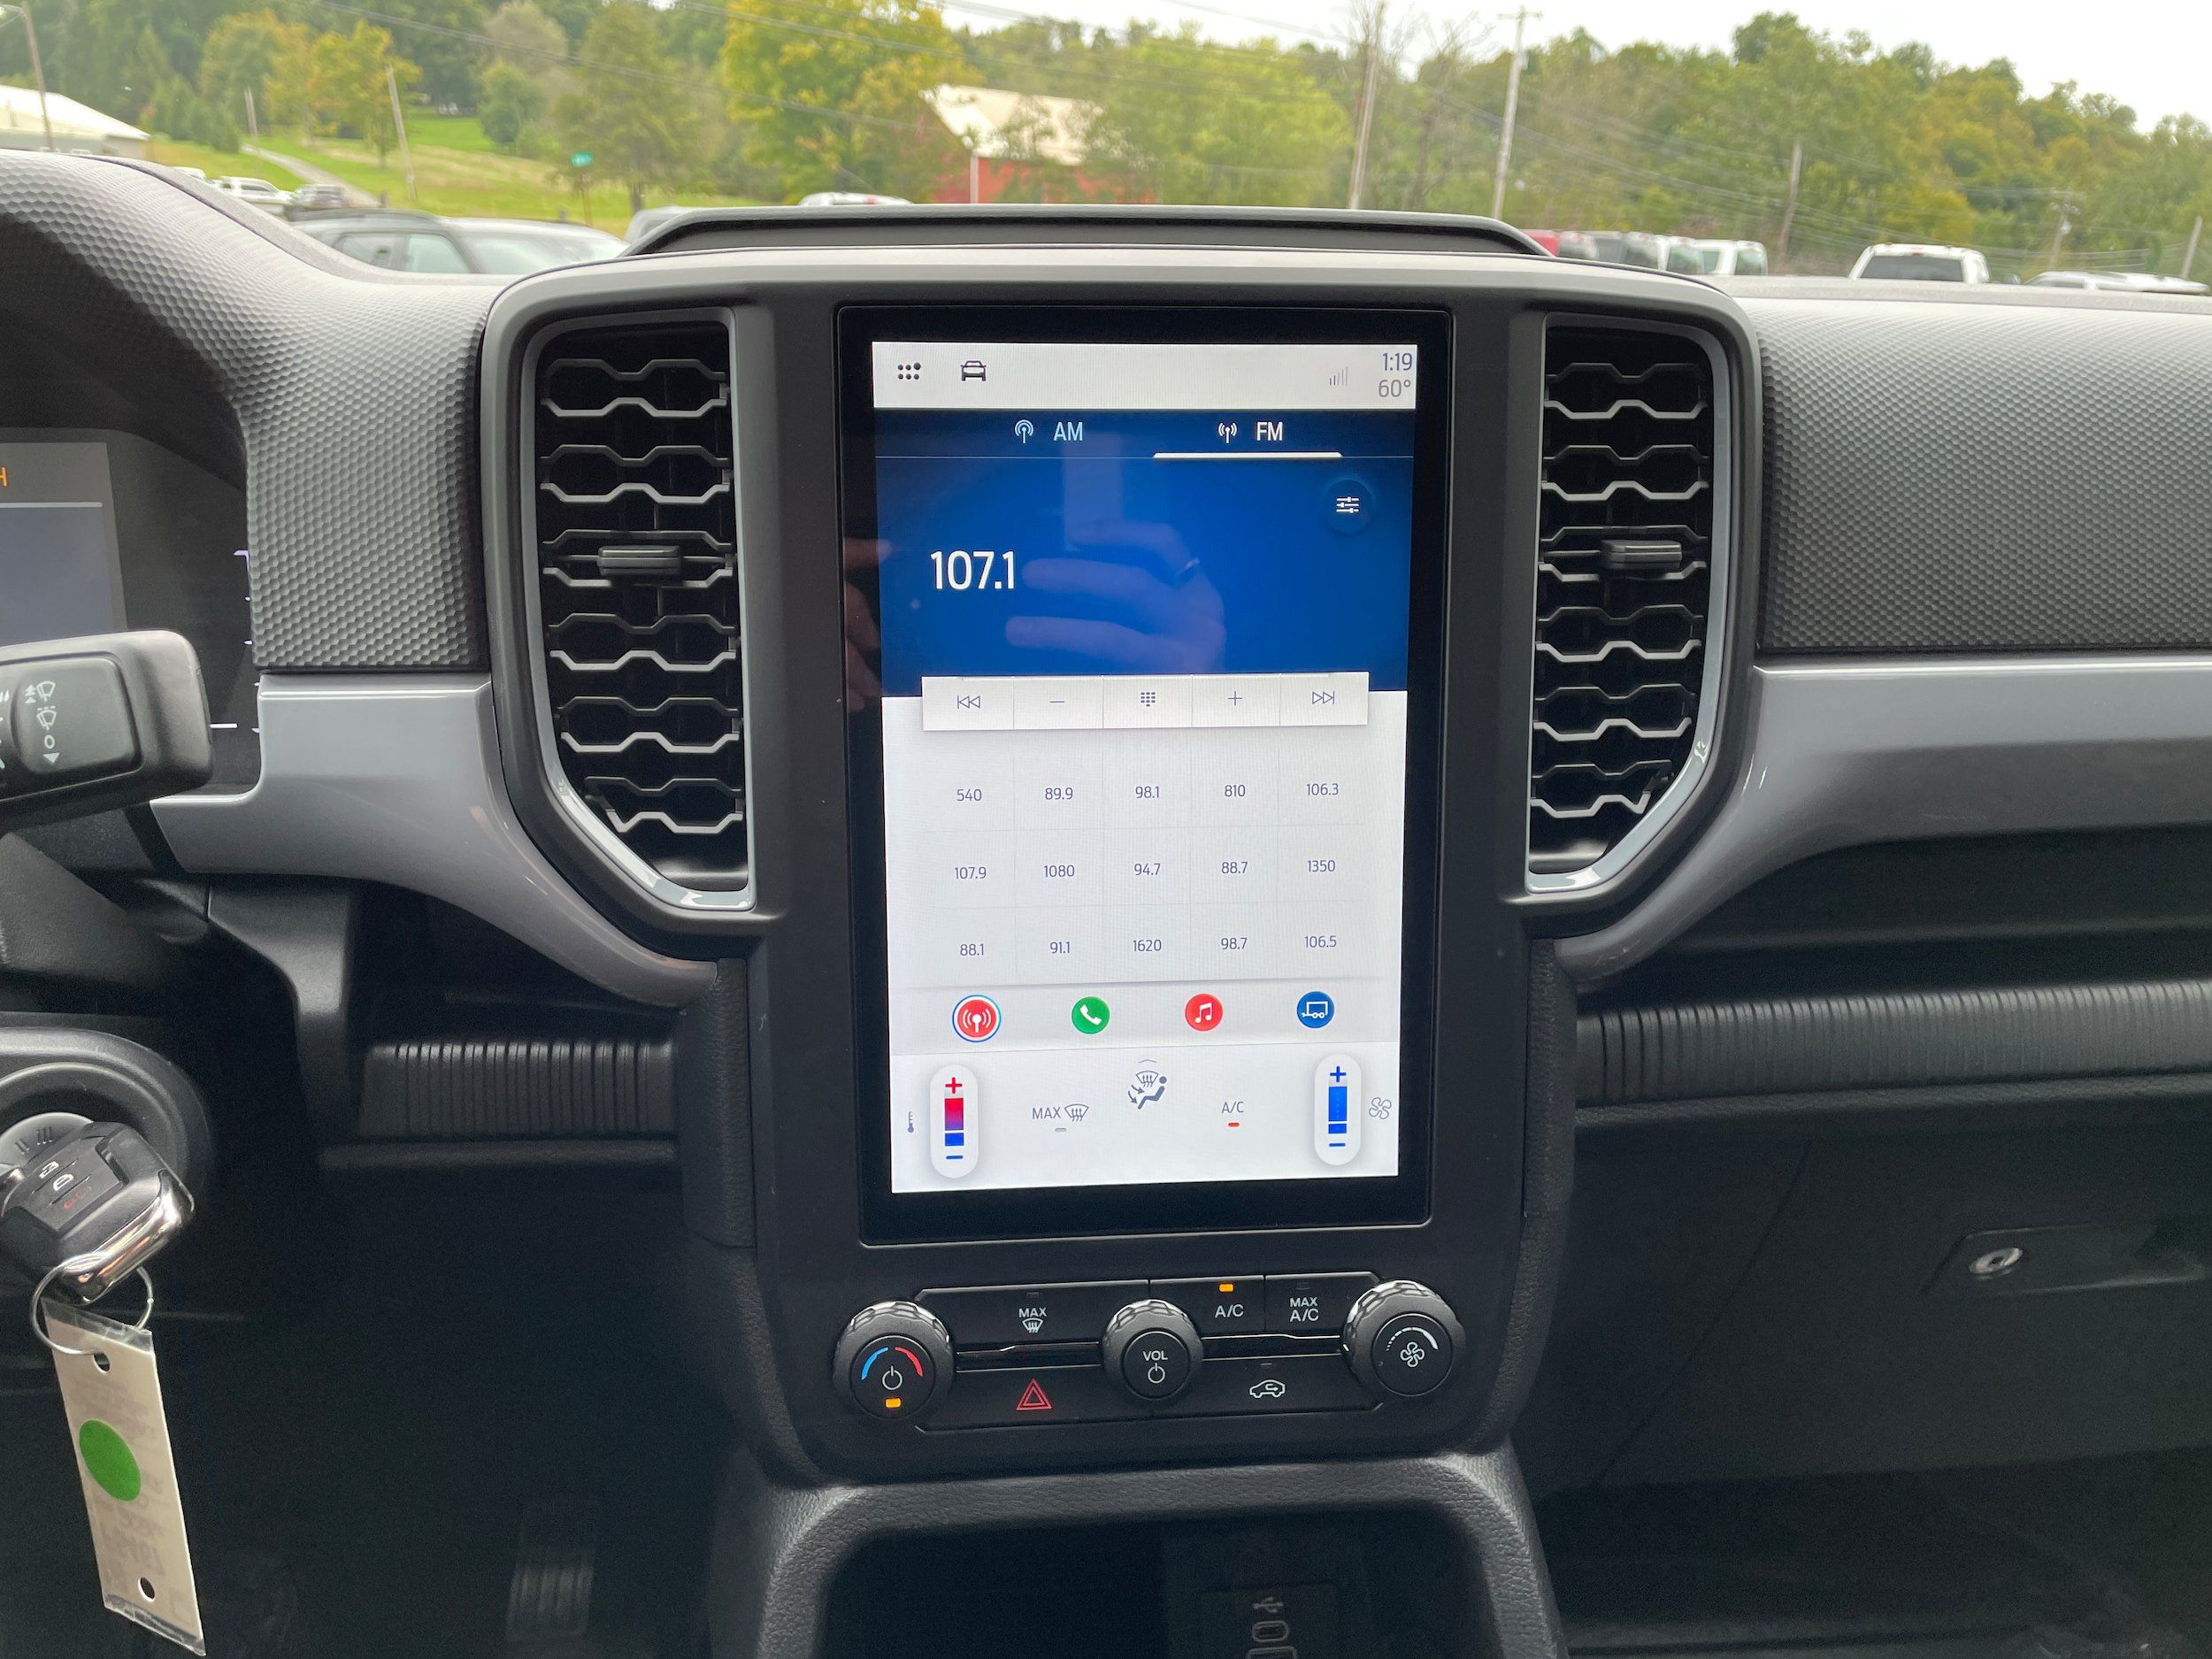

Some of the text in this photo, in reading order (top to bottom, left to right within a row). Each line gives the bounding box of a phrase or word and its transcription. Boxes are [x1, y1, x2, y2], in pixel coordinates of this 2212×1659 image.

[1382, 352, 1413, 372] 1:19
[1378, 379, 1411, 398] 60°
[1053, 421, 1083, 442] AM
[1256, 421, 1283, 442] FM
[930, 550, 1015, 590] 107.1
[956, 788, 982, 802] 540
[1045, 787, 1073, 801] 89.9
[1135, 786, 1159, 799] 98.1
[1224, 784, 1246, 797] 810
[1307, 782, 1339, 796] 106.3
[1044, 864, 1075, 878] 1080
[1133, 863, 1161, 876] 94.7
[1221, 861, 1248, 874] 88.7
[1308, 859, 1336, 872] 1350
[954, 866, 987, 879] 107.9
[1049, 941, 1071, 954] 91.1
[1133, 939, 1162, 952] 1620
[1220, 937, 1248, 950] 98.7
[1305, 935, 1337, 949] 106.5
[960, 943, 984, 956] 88.1
[1032, 1106, 1061, 1119] MAX
[1221, 1101, 1244, 1114] A/C
[1289, 1296, 1318, 1308] MAX
[1018, 1307, 1048, 1318] MAX
[1214, 1303, 1244, 1318] A/C
[1289, 1308, 1319, 1323] A/C
[1142, 1349, 1169, 1362] VOL
